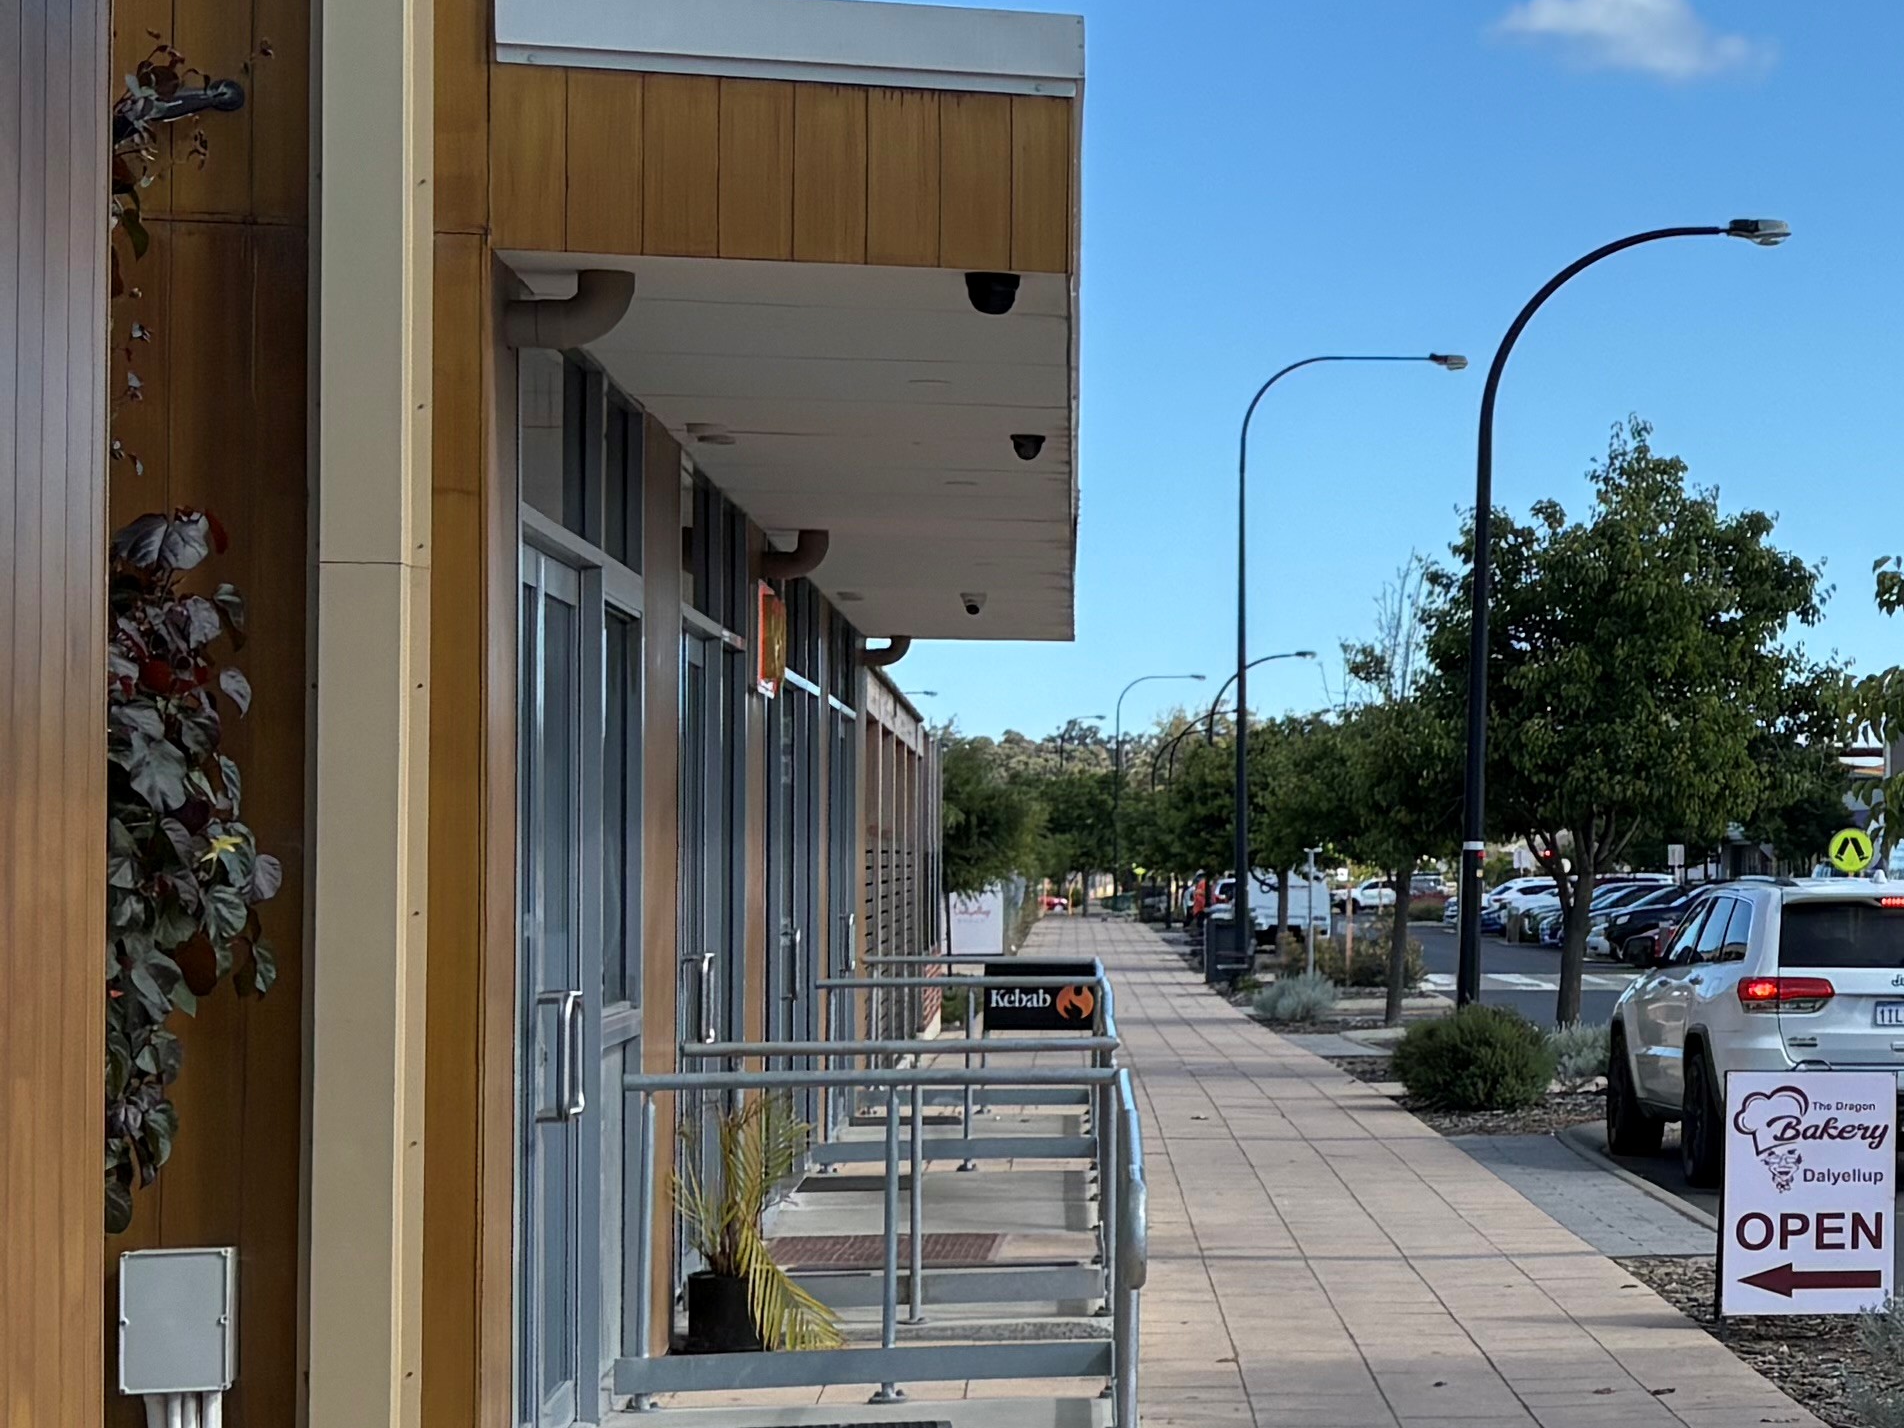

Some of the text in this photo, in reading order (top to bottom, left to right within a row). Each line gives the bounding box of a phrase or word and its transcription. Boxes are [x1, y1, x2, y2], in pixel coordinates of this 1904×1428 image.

[990, 989, 1051, 1008] Kebab
[1811, 1102, 1876, 1113] The Dragon
[1766, 1116, 1889, 1150] Bakery
[1803, 1169, 1884, 1186] Dalyellup
[1736, 1212, 1883, 1251] OPEN
